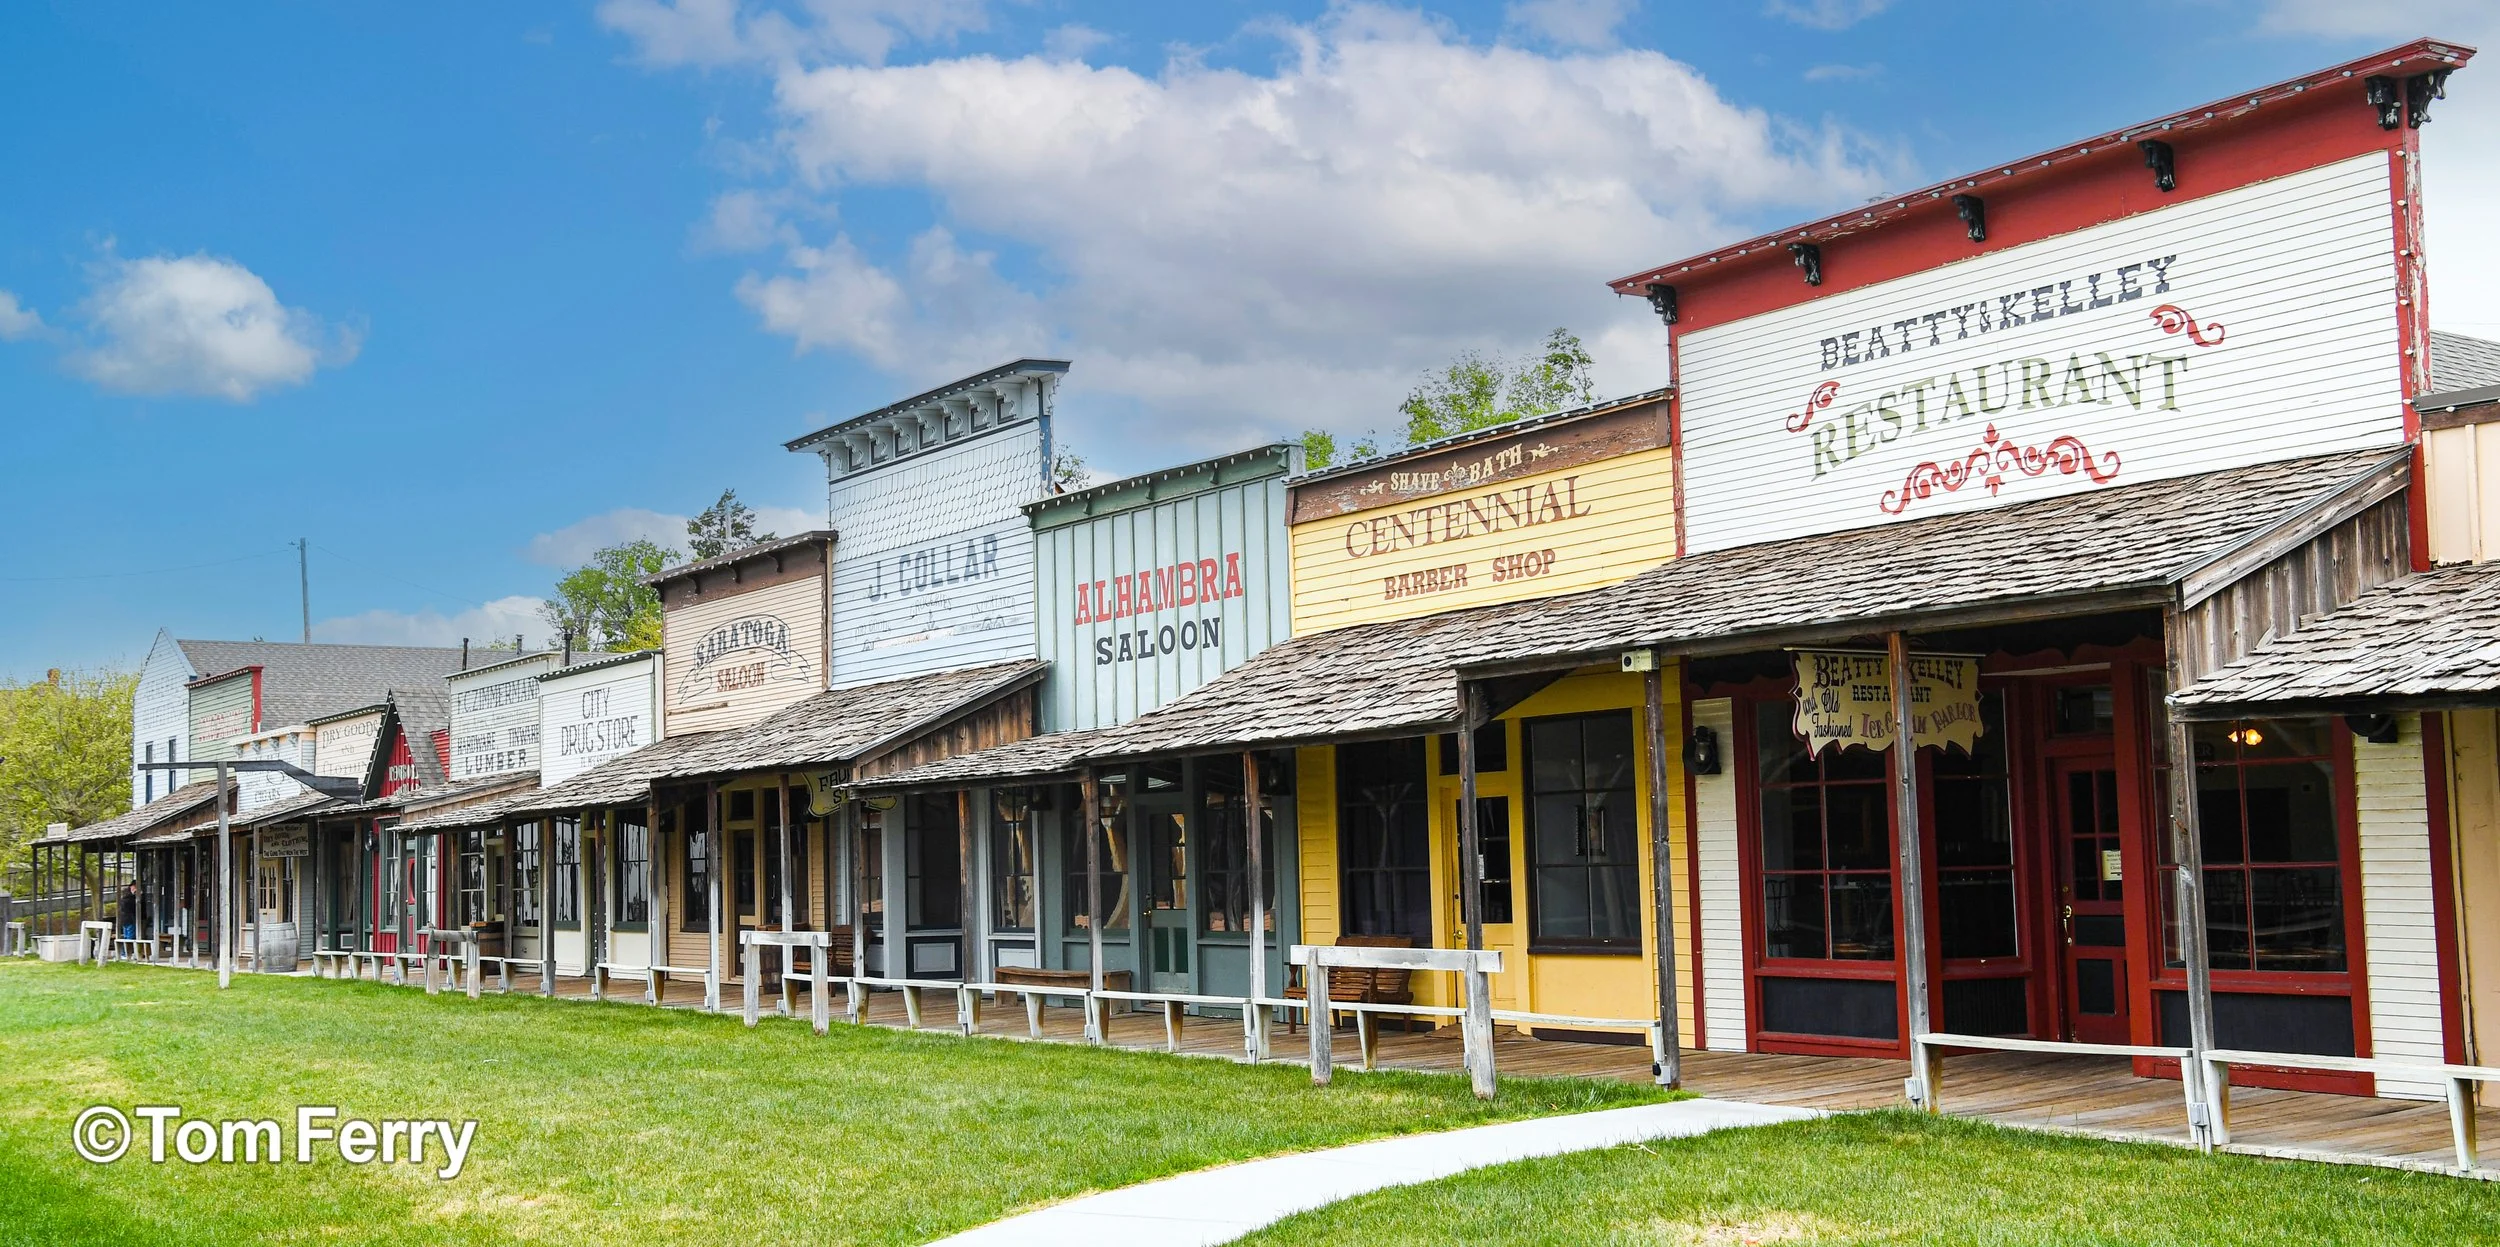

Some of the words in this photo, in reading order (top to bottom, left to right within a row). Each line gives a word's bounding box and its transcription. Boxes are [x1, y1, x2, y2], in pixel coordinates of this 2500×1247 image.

[1820, 303, 1975, 371] BEATTY
[1999, 254, 2177, 329] KELLEY
[1809, 351, 2189, 482] RESTAURANT
[1390, 470, 1440, 492] SHAVE
[1468, 443, 1523, 485] BATH
[1345, 475, 1592, 560] CENTENNIAL
[899, 533, 1000, 596] COLLAR
[1075, 552, 1244, 626] ALHAMBRA
[1384, 563, 1468, 601] BARBER
[1492, 548, 1557, 584] SHOP
[697, 619, 789, 668] SARATOGA
[1096, 616, 1221, 666] SALOON
[716, 661, 766, 693] SALOON
[1812, 654, 1884, 688] BEATTY
[582, 687, 611, 719] CITY
[1812, 713, 1854, 738] Fashioned
[1860, 713, 1885, 739] ICE
[322, 727, 341, 749] DRY
[344, 719, 380, 737] GOODS
[560, 722, 594, 756] DRUG
[596, 715, 639, 752] STORE
[465, 748, 527, 775] LUMBER
